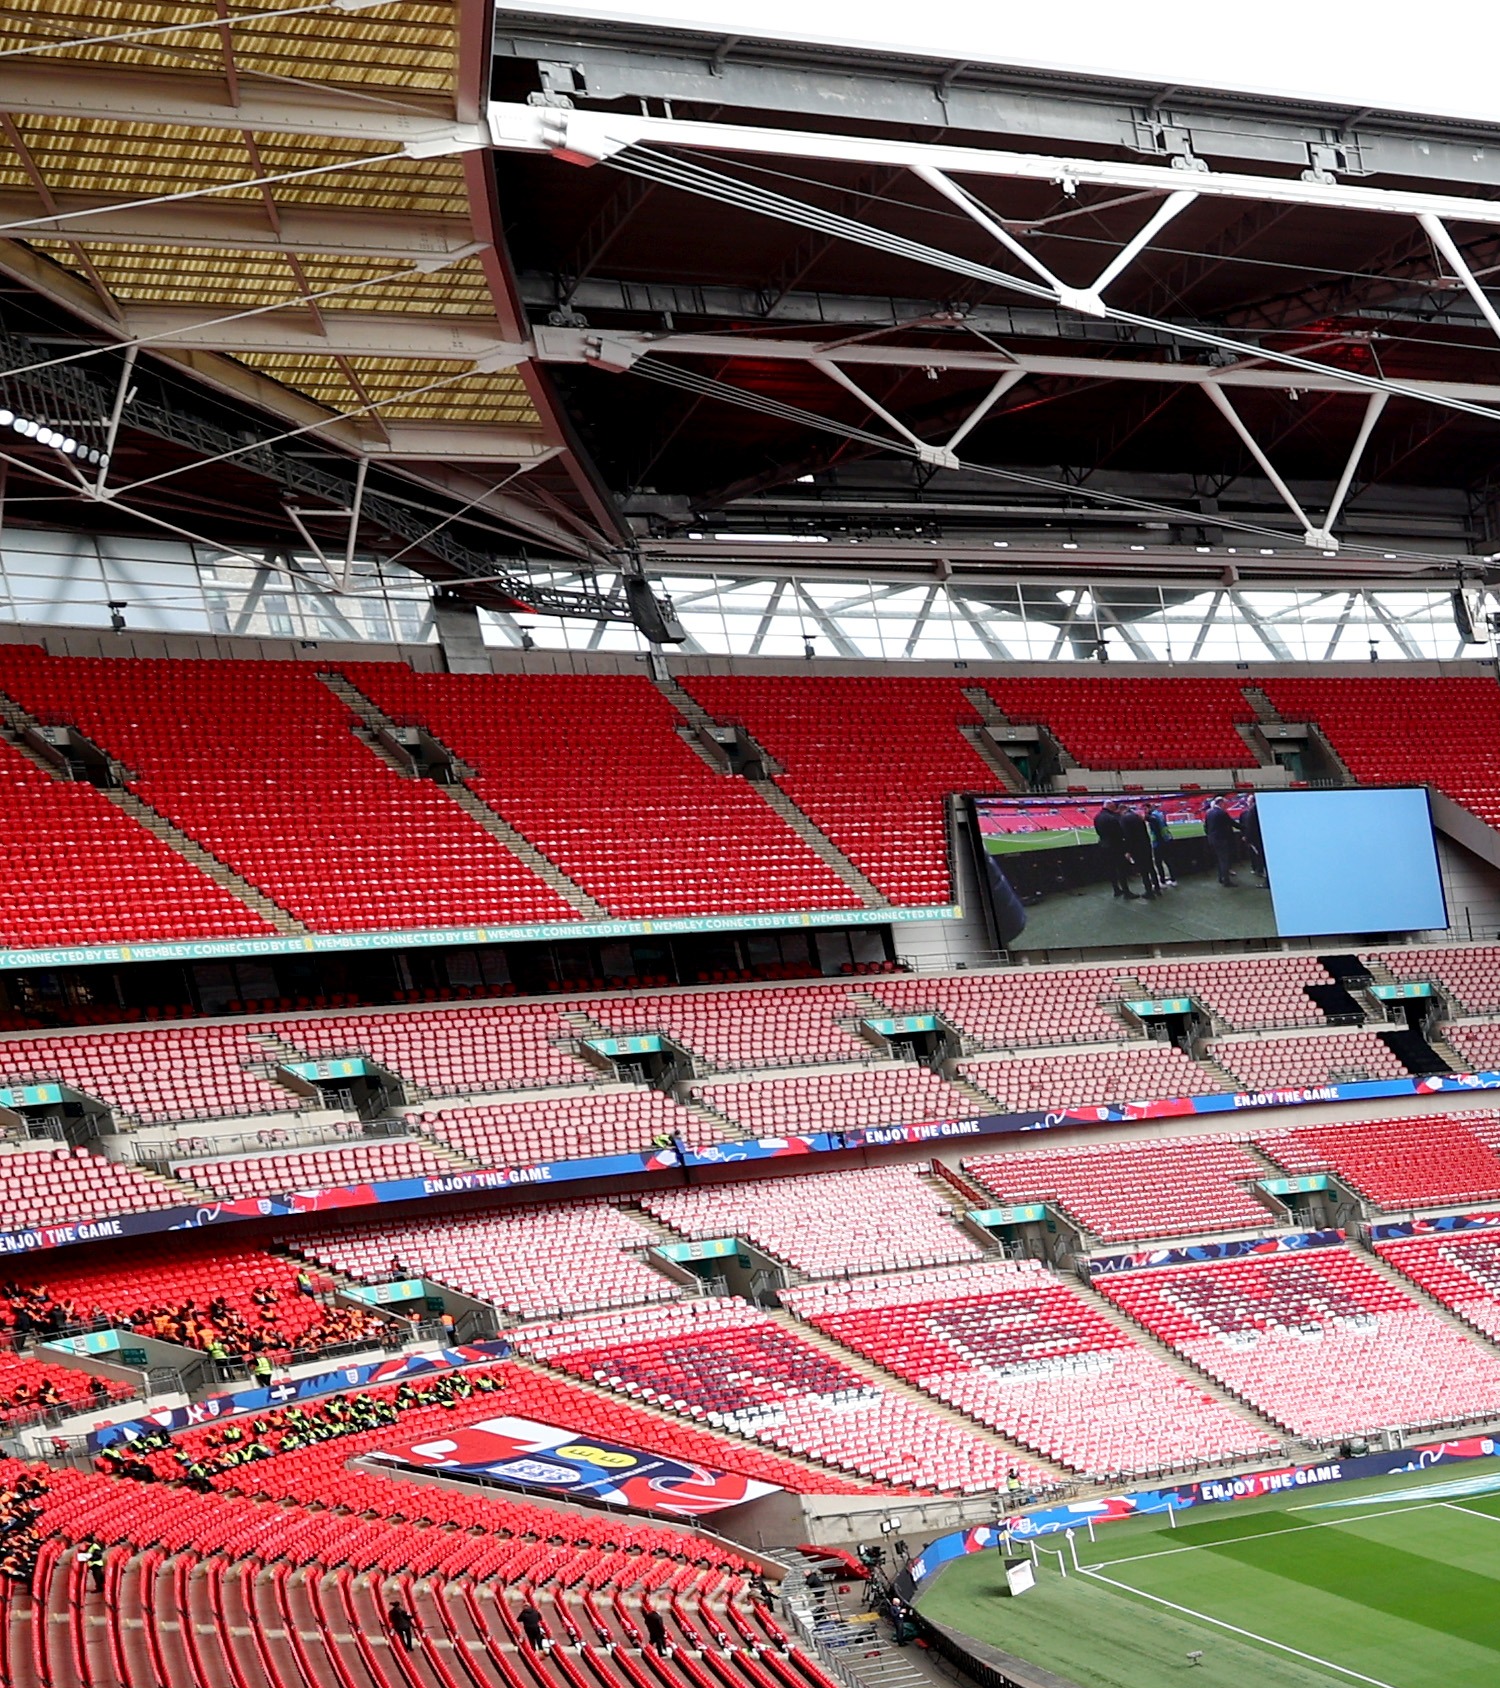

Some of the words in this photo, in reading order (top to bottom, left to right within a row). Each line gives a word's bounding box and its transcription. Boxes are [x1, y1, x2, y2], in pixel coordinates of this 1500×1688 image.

[812, 912, 859, 924] WEMBLEY
[861, 910, 925, 921] CONNECTED
[926, 909, 939, 918] BY
[942, 909, 953, 917] EE
[134, 946, 190, 959] WEMBLEY
[193, 942, 269, 956] CONNECTED
[271, 941, 286, 953] BY
[290, 940, 302, 952] EE
[316, 936, 369, 950] WEMBLEY
[372, 933, 444, 947] CONNECTED
[446, 932, 460, 943] BY
[464, 932, 476, 942] EE
[8, 951, 83, 966] CONNECTED
[87, 950, 104, 961] BY
[107, 949, 118, 960] EE
[1234, 1093, 1273, 1106] ENJOY
[1276, 1091, 1300, 1102] THE
[1303, 1088, 1339, 1100] GAME
[866, 1128, 908, 1143] ENJOY
[912, 1125, 939, 1138] THE
[940, 1119, 980, 1135] GAME
[423, 1173, 472, 1193] ENJOY
[476, 1172, 506, 1186] THE
[509, 1167, 551, 1183] GAME
[0, 1231, 42, 1251] ENJOY
[46, 1227, 75, 1243] THE
[78, 1221, 122, 1238] GAME
[1202, 1478, 1255, 1500] ENJOY
[1260, 1473, 1292, 1490] THE
[1295, 1466, 1341, 1484] GAME
